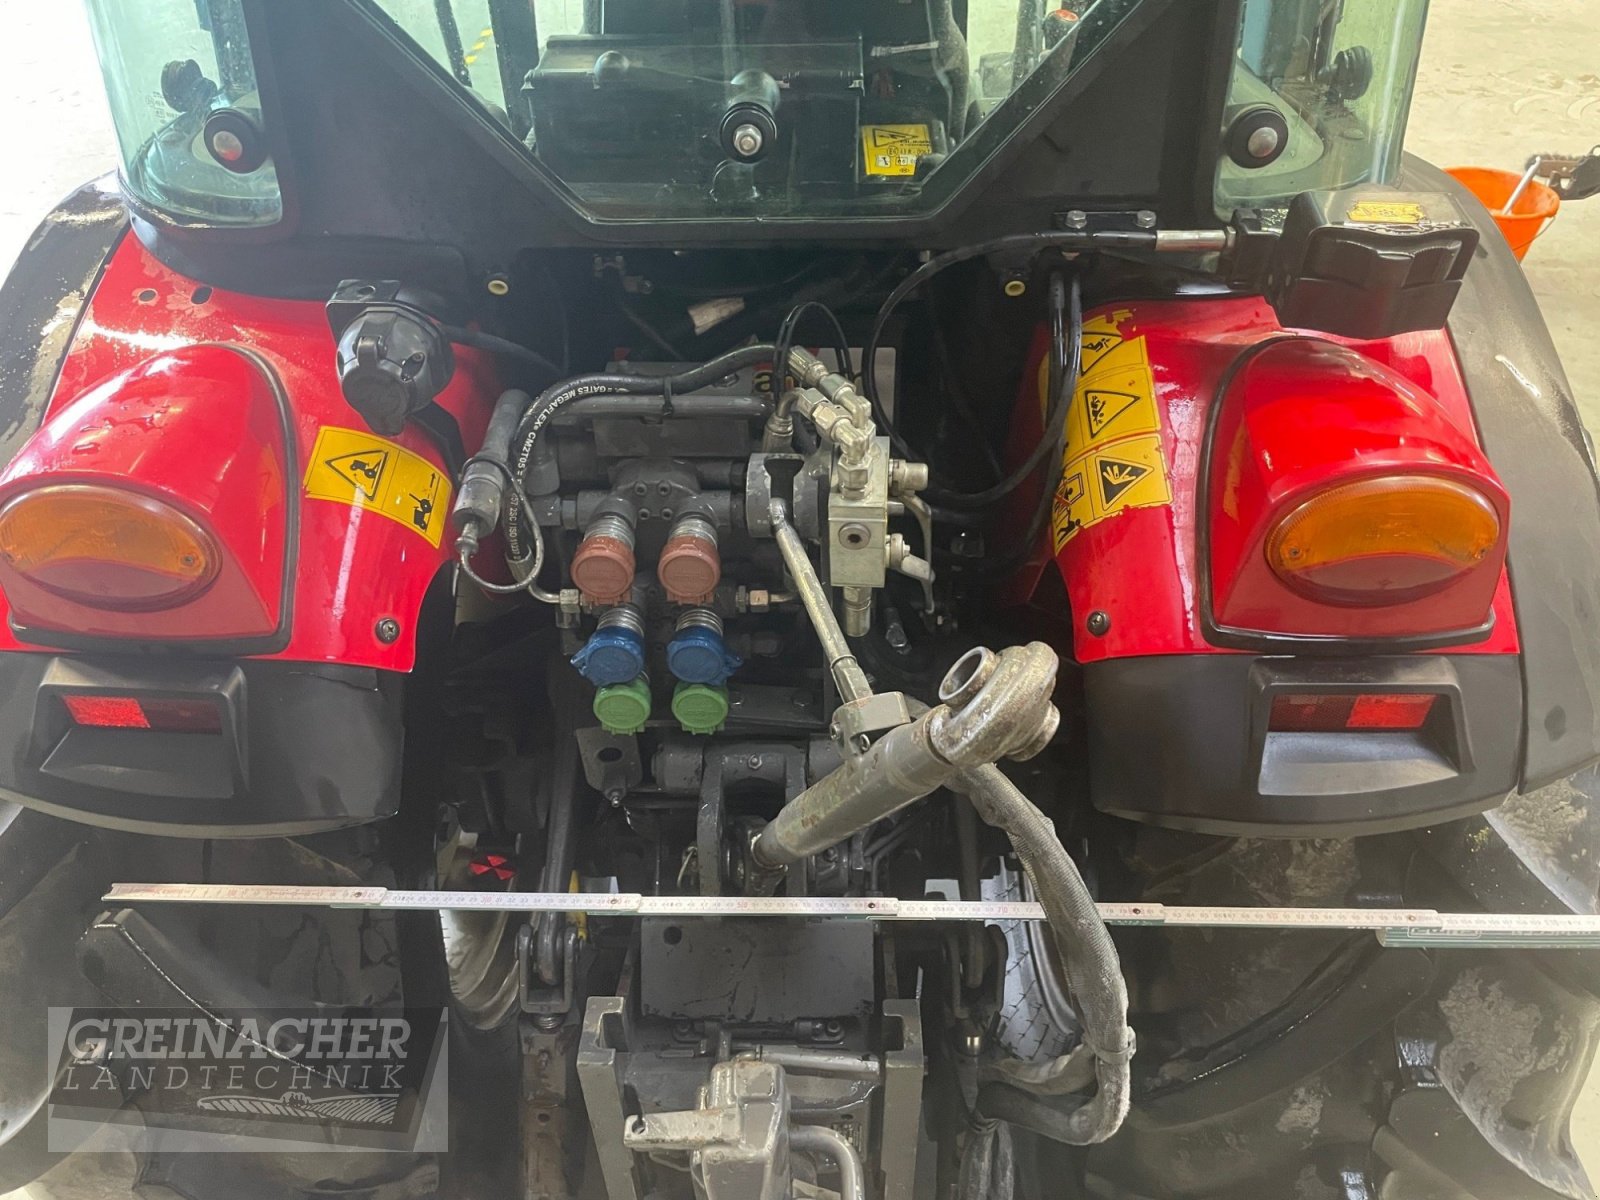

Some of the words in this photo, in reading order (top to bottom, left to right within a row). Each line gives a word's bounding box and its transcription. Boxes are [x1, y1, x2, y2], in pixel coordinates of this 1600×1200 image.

[577, 385, 607, 395] GATES
[509, 507, 518, 522] 2SC
[508, 526, 518, 538] ISO
